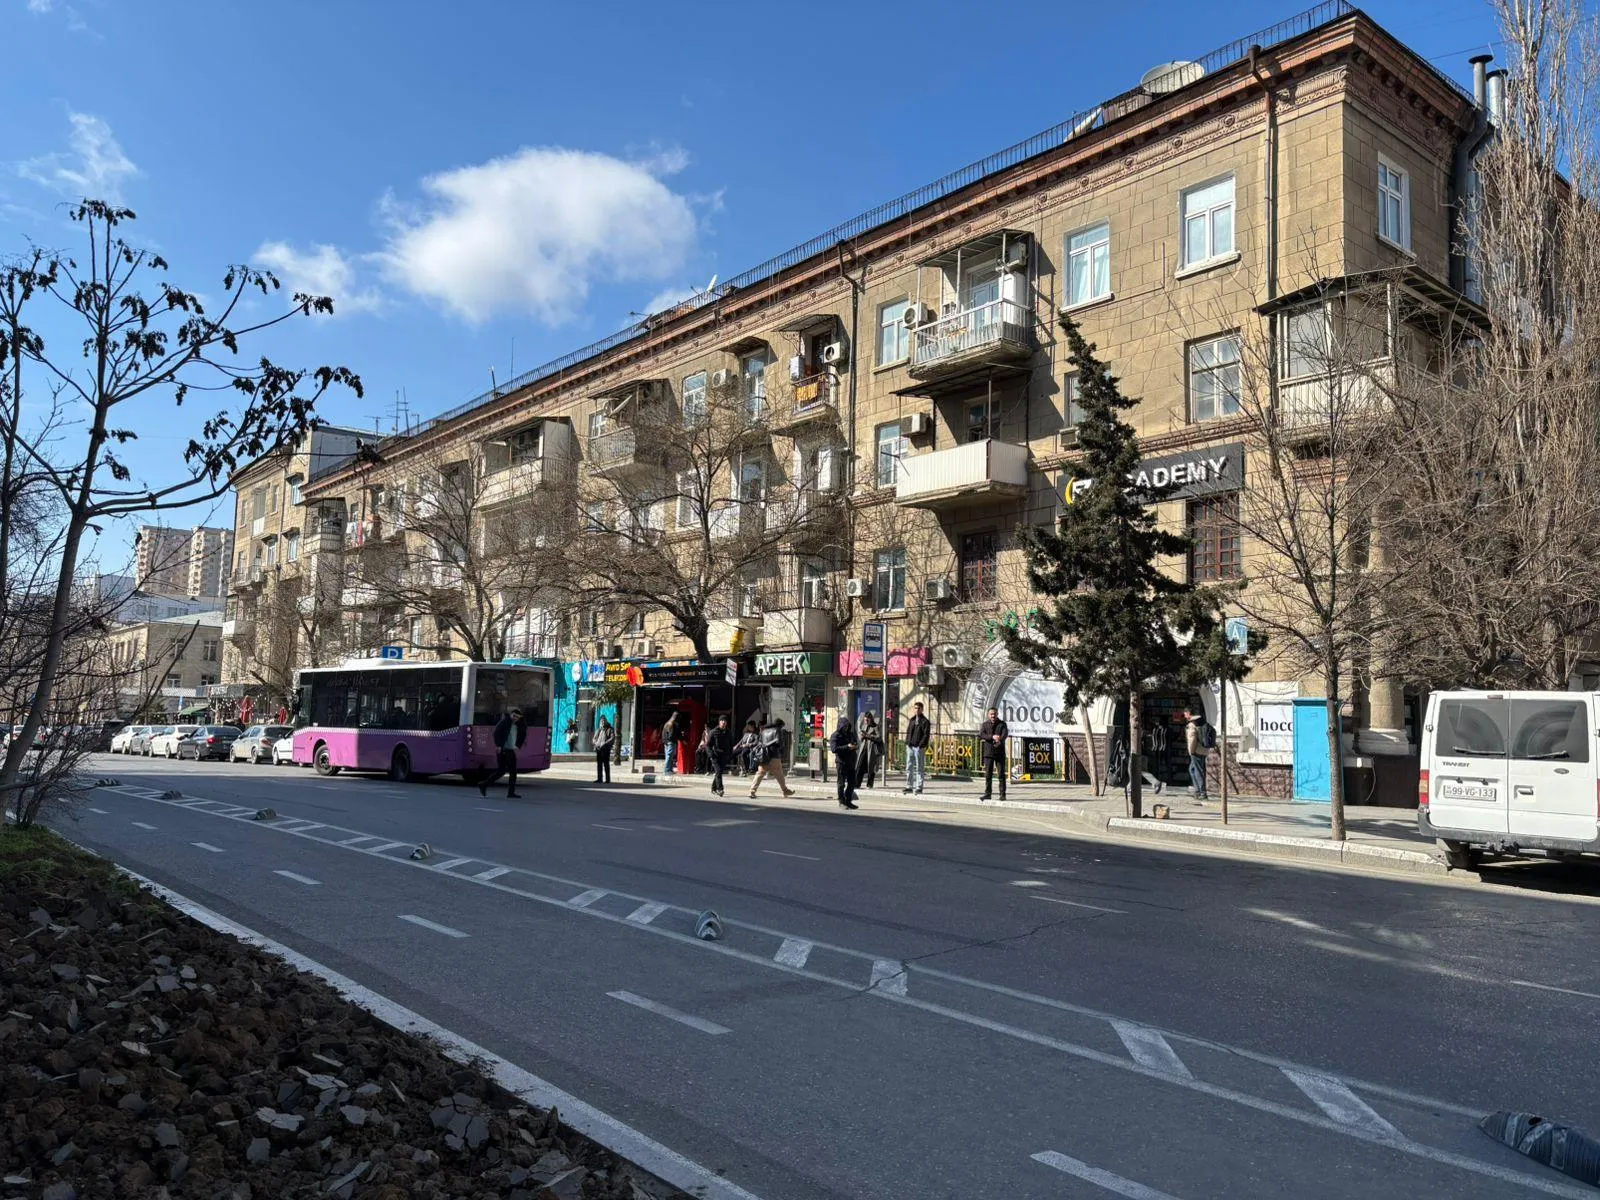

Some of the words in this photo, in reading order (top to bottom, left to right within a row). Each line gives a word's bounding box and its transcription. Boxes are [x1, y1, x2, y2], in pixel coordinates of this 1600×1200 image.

[756, 653, 804, 675] APTEK
[1029, 743, 1050, 751] GAME
[1029, 752, 1050, 763] BOX
